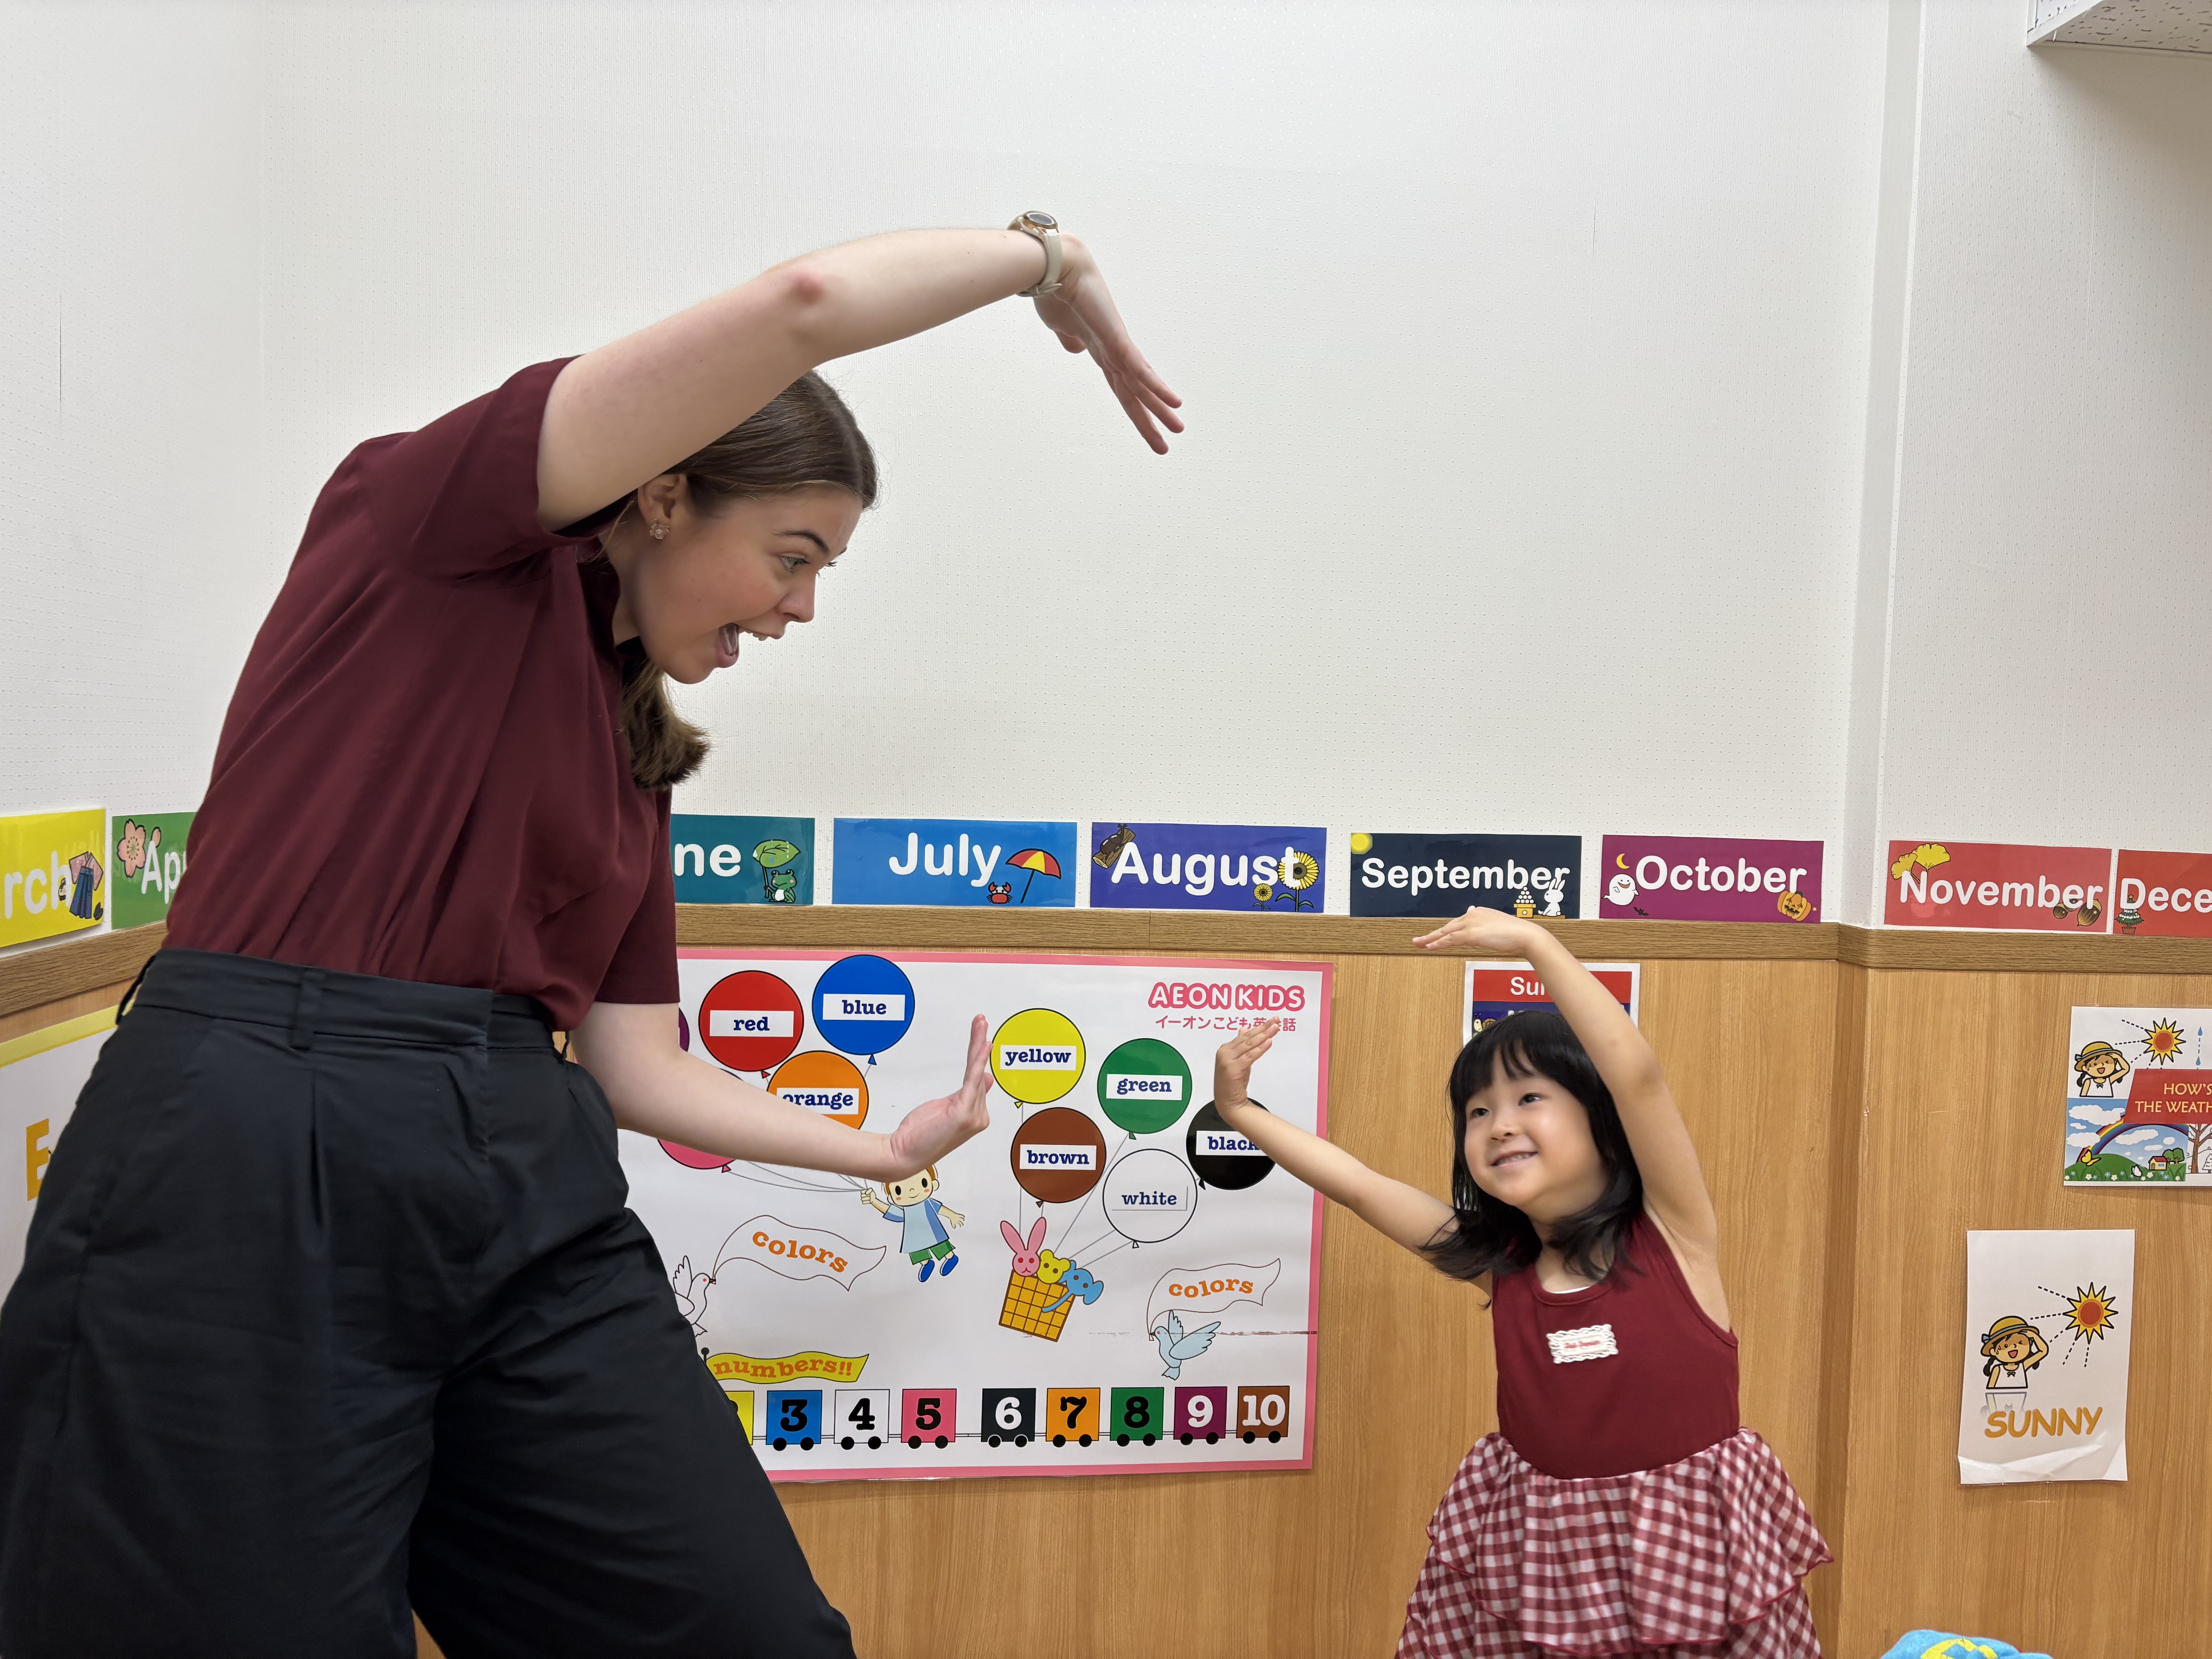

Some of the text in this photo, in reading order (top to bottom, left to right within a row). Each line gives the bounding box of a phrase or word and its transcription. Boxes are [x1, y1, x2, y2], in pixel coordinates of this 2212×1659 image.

[674, 843, 741, 877] ne
[889, 832, 1001, 887] July
[1111, 842, 1301, 896] August
[1362, 857, 1570, 896] September
[1635, 855, 1807, 893] October
[1900, 871, 2103, 910] November
[2120, 878, 2212, 913] Dece
[842, 1000, 887, 1015] blue
[1149, 982, 1305, 1011] AEON KIDS
[733, 1017, 770, 1031] red
[1155, 1015, 1297, 1032] イーオンこども英話
[1005, 1049, 1072, 1066] yellow
[1116, 1077, 1172, 1093] green
[2164, 1083, 2212, 1096] HOW'S
[2135, 1101, 2162, 1113] THE
[1027, 1149, 1090, 1165] brown
[1121, 1192, 1177, 1206] white
[752, 1231, 848, 1273] colors
[1168, 1278, 1254, 1298] colors
[714, 1358, 852, 1378] numbers!!
[780, 1394, 1286, 1432] 3 4 5 6 7 8 9 10
[1984, 1407, 2103, 1438] SUNNY
